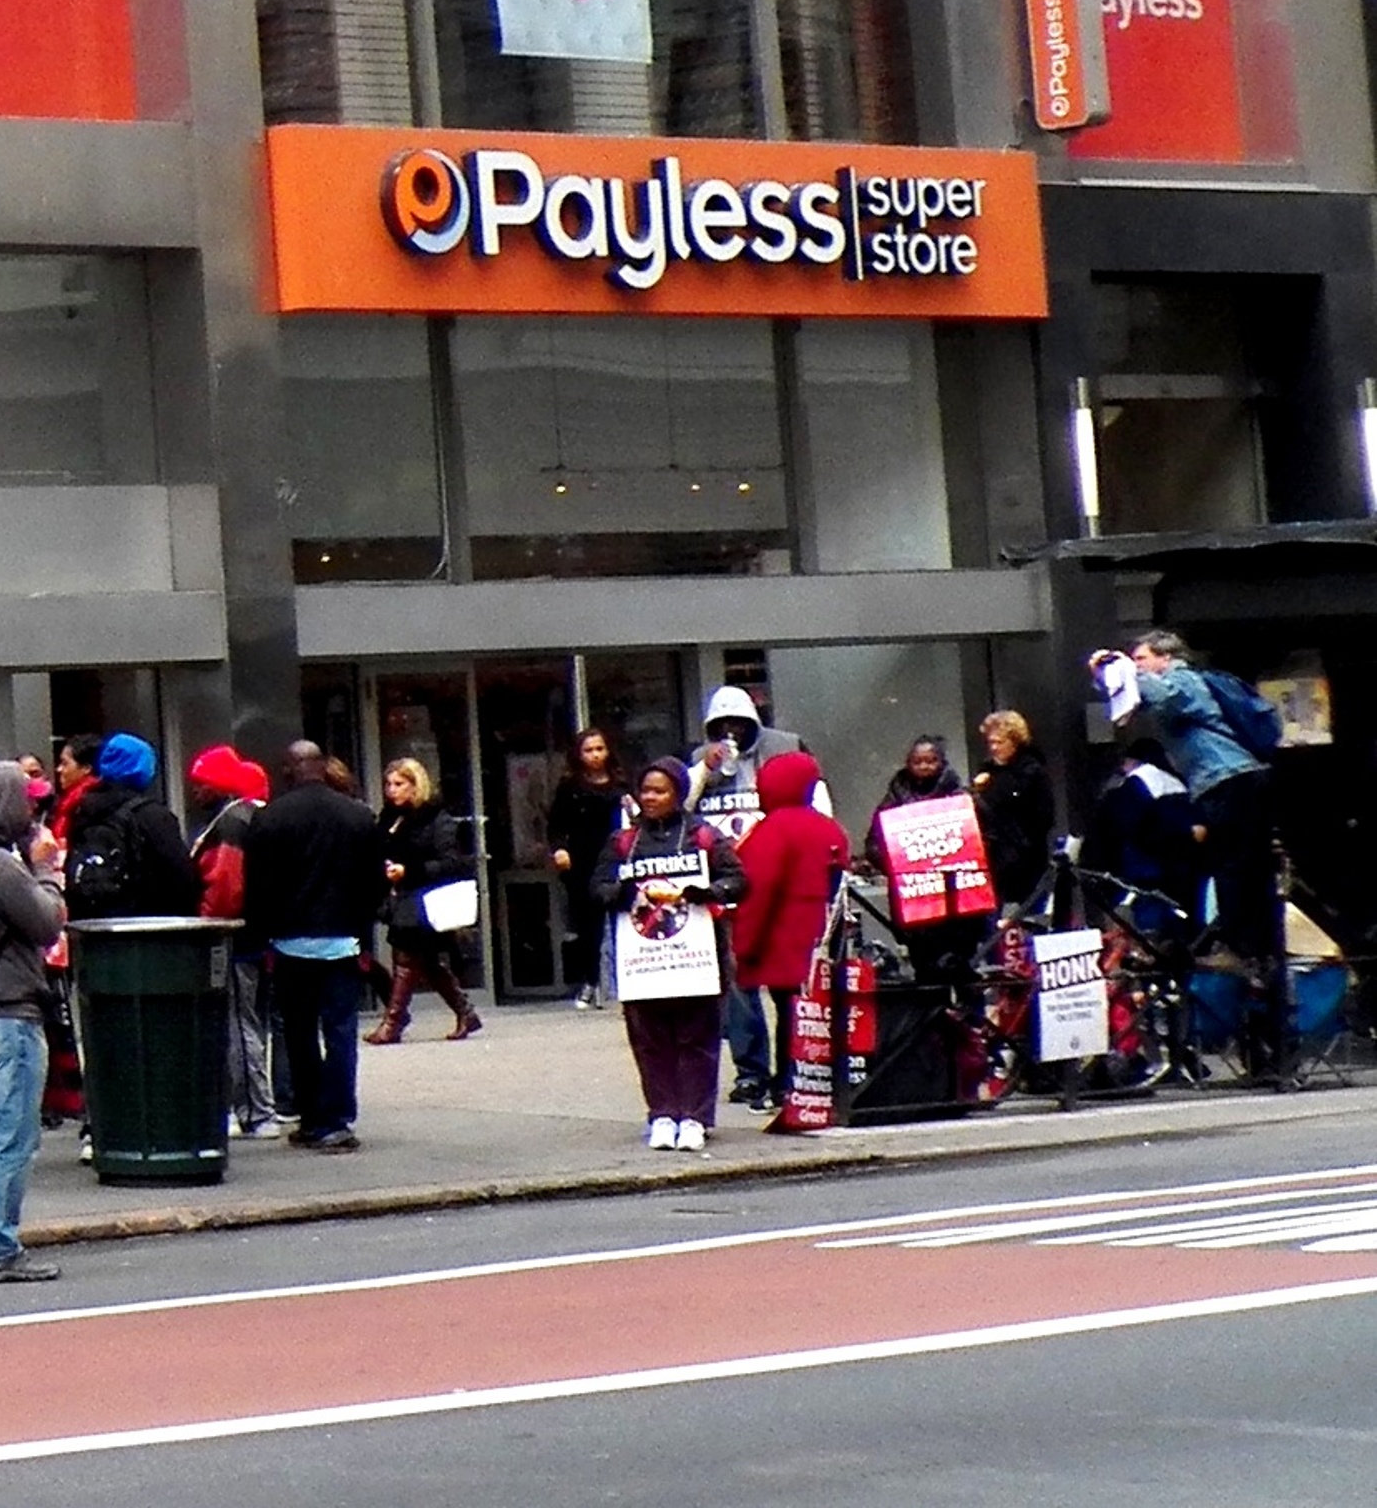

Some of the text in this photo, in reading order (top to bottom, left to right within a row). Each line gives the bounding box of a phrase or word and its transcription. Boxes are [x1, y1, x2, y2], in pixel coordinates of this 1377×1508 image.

[469, 148, 844, 291] Payless
[866, 175, 986, 237] super
[872, 227, 978, 275] store
[723, 792, 760, 810] STRI
[635, 853, 700, 877] STRIKE
[1040, 952, 1103, 990] HONK
